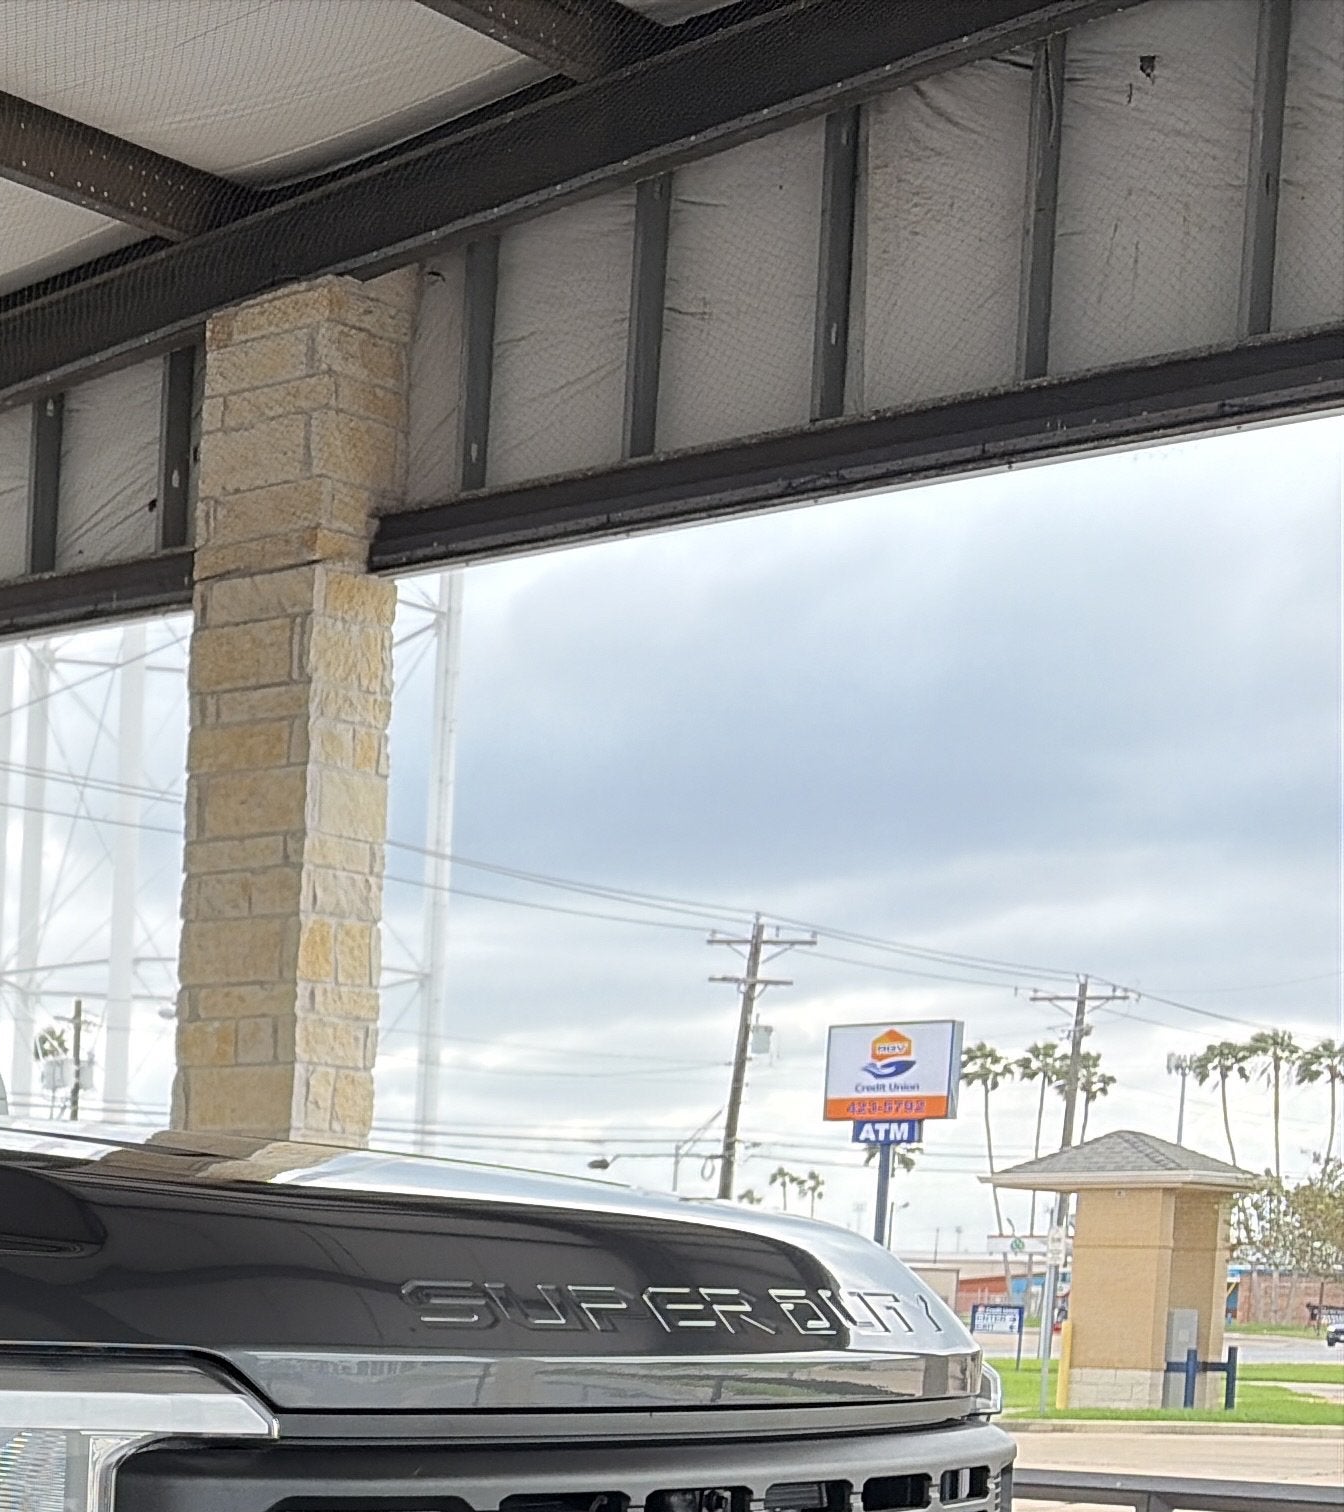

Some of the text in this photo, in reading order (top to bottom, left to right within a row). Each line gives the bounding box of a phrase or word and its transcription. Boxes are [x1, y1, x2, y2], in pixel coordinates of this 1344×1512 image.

[855, 1081, 921, 1094] Credit Union
[858, 1122, 910, 1141] ATM
[400, 1278, 944, 1335] SUPER DUTY
